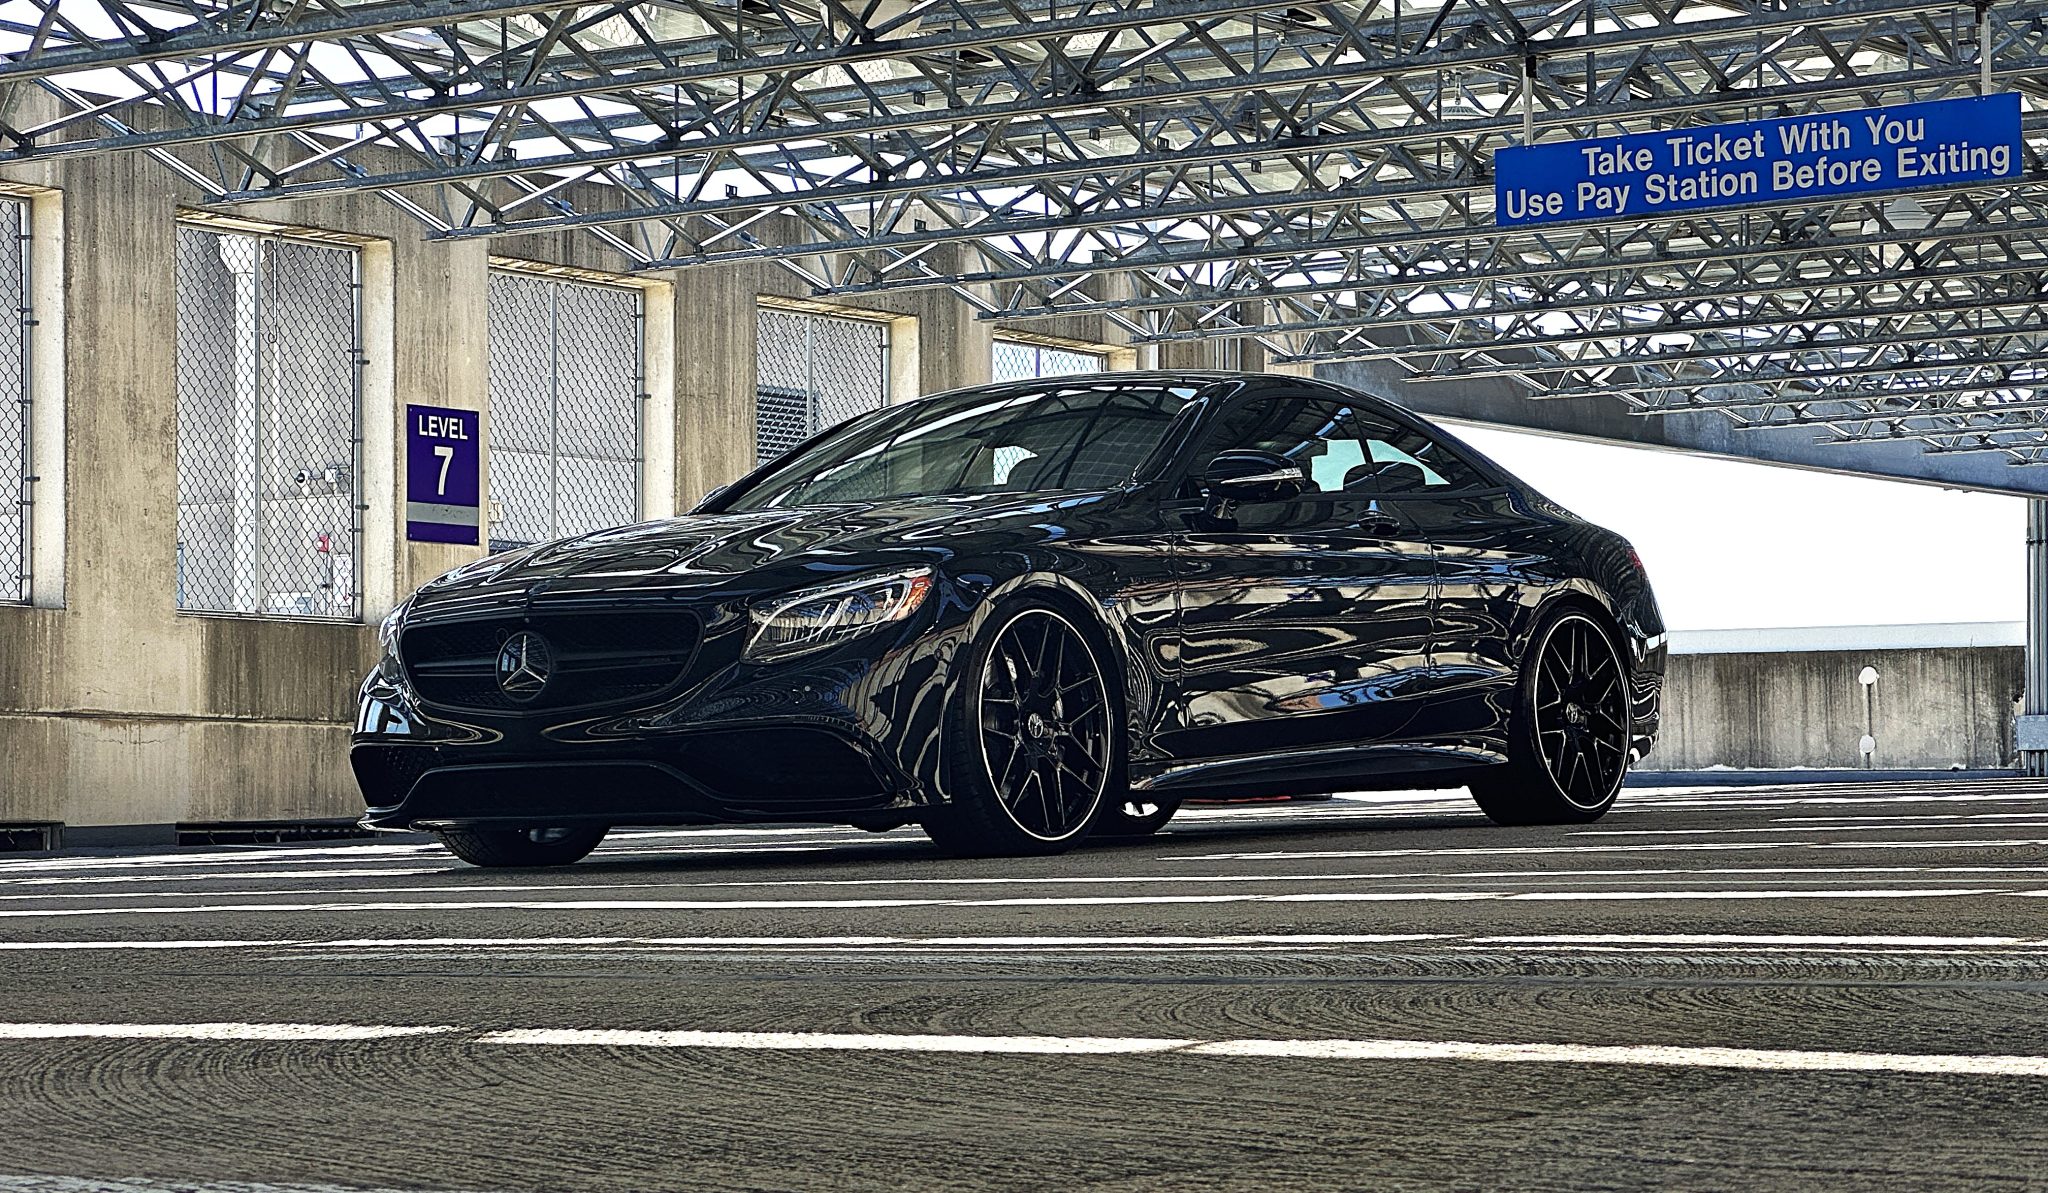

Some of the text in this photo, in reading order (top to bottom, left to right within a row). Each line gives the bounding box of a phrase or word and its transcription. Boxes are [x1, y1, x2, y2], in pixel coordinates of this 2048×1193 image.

[1582, 115, 1924, 175] Take Ticket With You
[1506, 142, 2010, 219] Use Pay Station Before Exiting
[418, 414, 468, 440] LEVEL
[434, 446, 454, 496] 7
